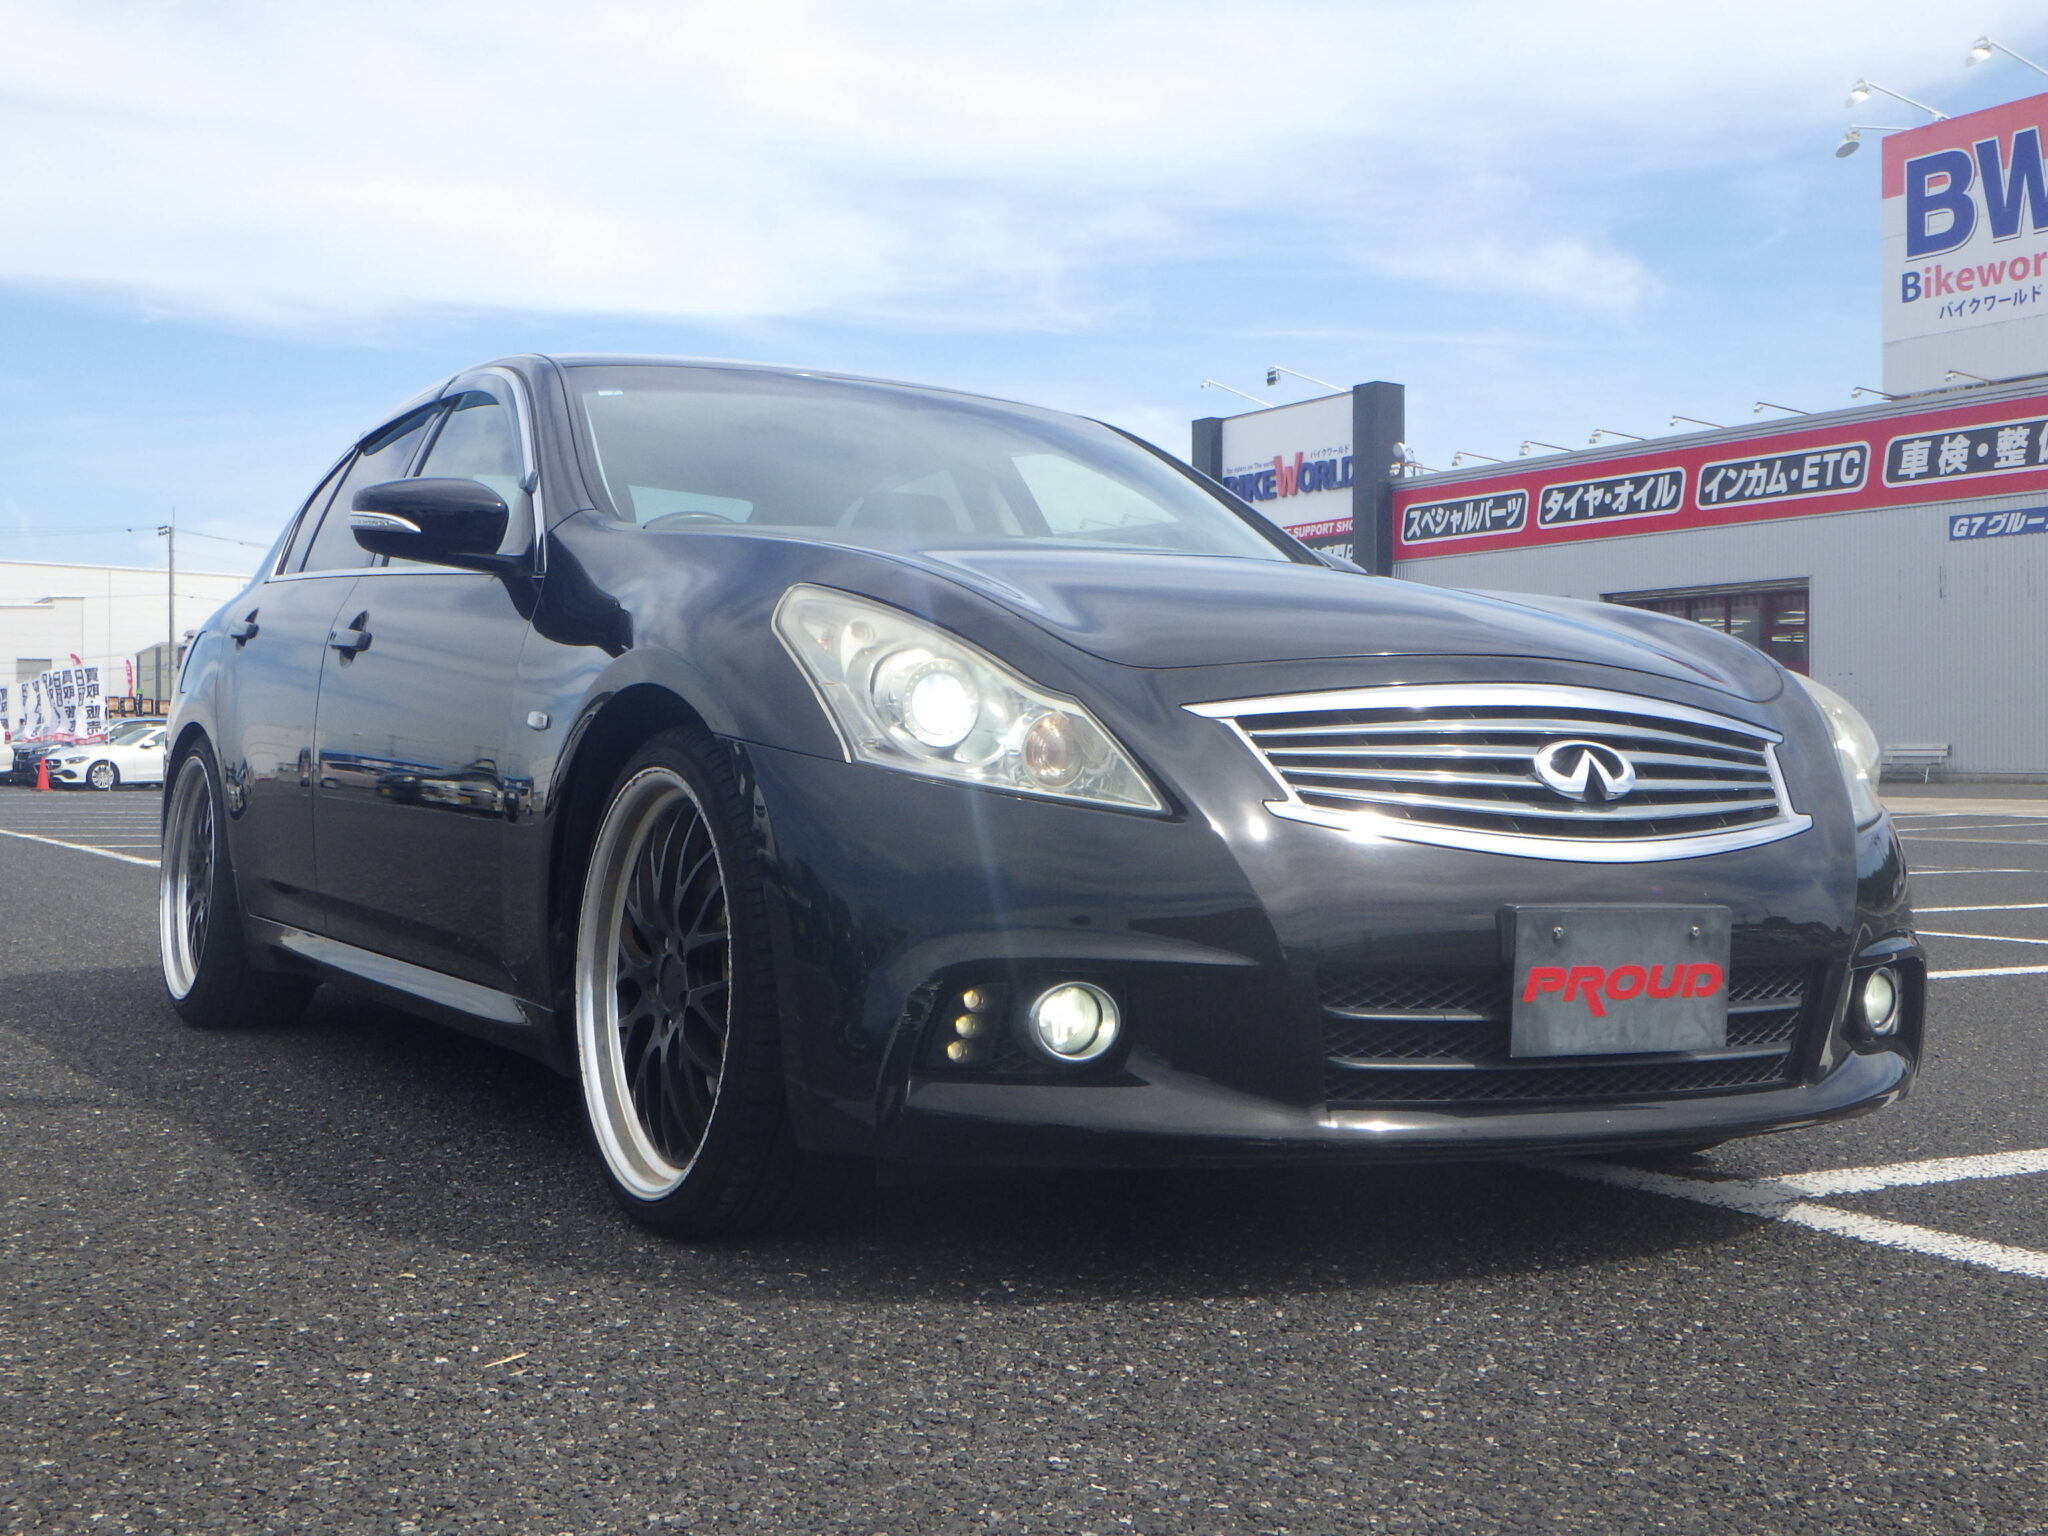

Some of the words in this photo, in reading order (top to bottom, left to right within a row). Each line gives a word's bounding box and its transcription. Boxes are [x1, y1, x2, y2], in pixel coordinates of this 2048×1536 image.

[1904, 126, 2048, 261] BW
[1902, 251, 2048, 303] Bikewor
[1939, 284, 2043, 320] バイクワールド
[1544, 474, 1678, 523] タイヤ・オイル
[1704, 449, 1862, 503] インカム・ETC
[1407, 496, 1523, 538] スペシャルパーツ
[1521, 963, 1724, 1018] PROUD
